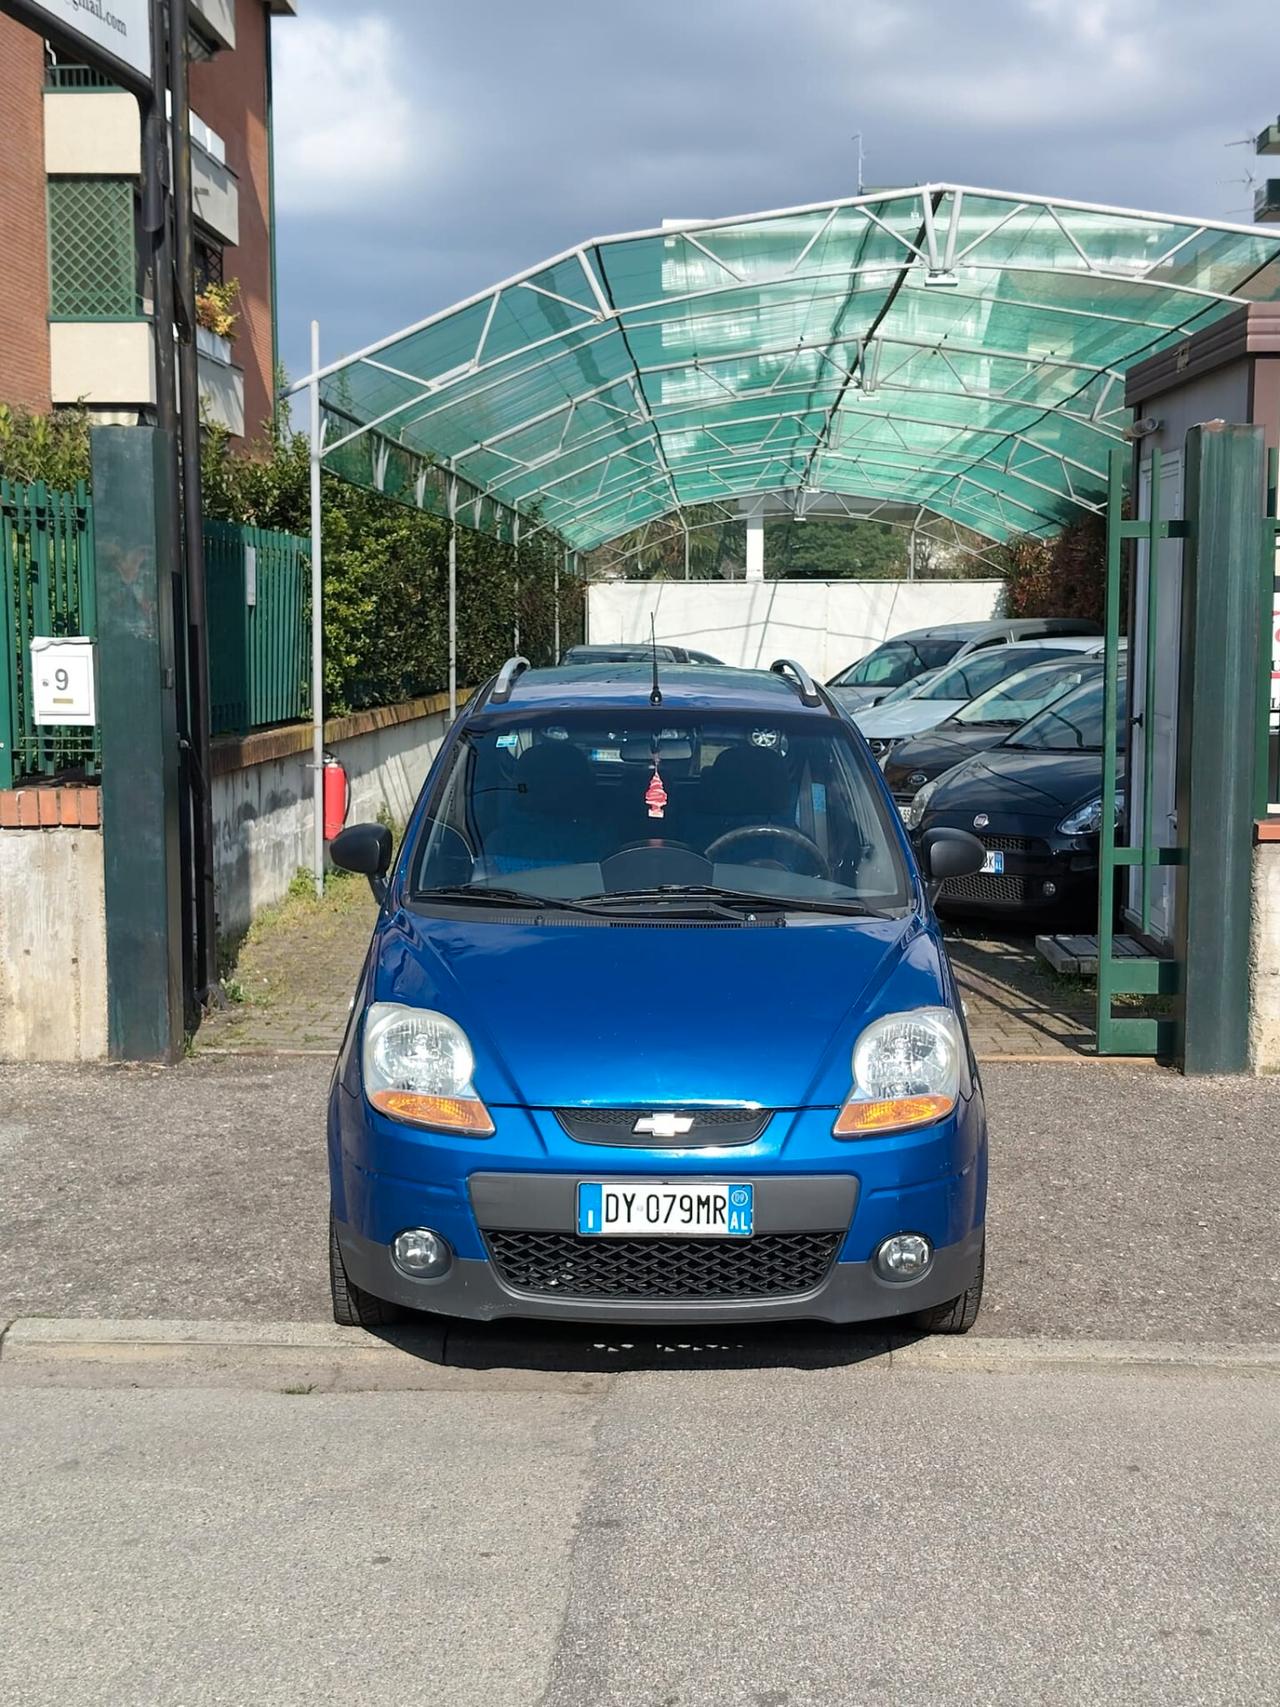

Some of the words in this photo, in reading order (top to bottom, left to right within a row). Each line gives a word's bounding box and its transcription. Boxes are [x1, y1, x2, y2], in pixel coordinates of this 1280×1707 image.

[55, 668, 69, 691] 9
[605, 1192, 636, 1224] DY
[646, 1193, 727, 1225] 079MR
[729, 1211, 748, 1231] AL
